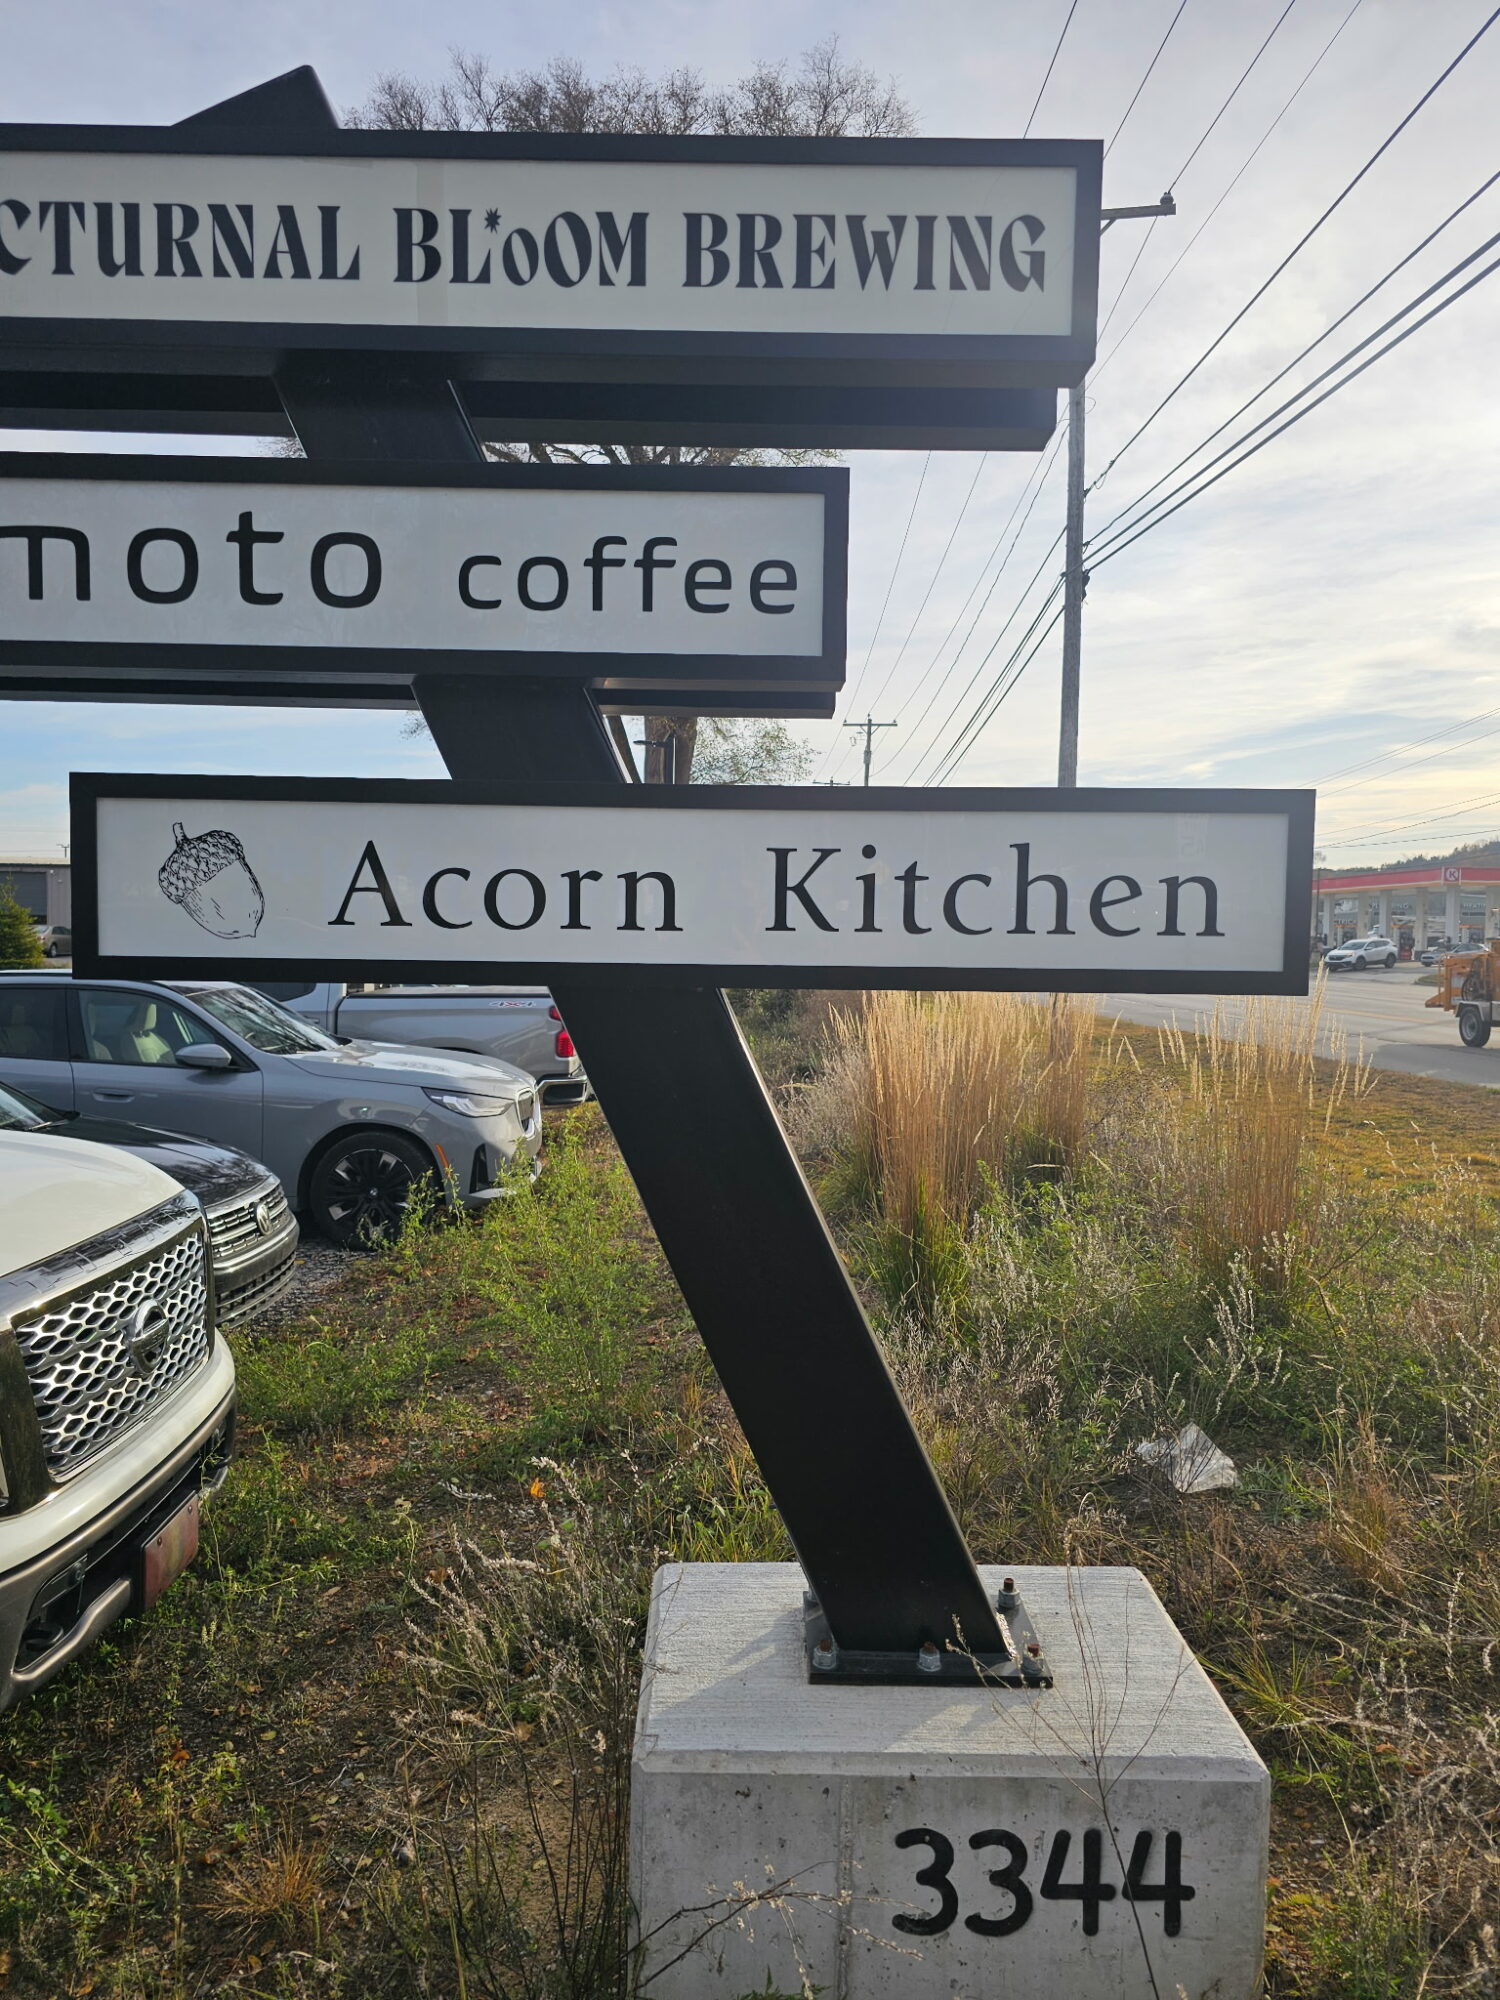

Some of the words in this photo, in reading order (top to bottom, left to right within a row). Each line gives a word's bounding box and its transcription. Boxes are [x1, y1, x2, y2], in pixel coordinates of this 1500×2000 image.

[682, 213, 1045, 292] BREWING
[0, 511, 382, 608] moto
[458, 535, 798, 614] coffee
[328, 840, 684, 931] Acorn
[765, 842, 1225, 937] Kitchen
[892, 1828, 1196, 1937] 3344
